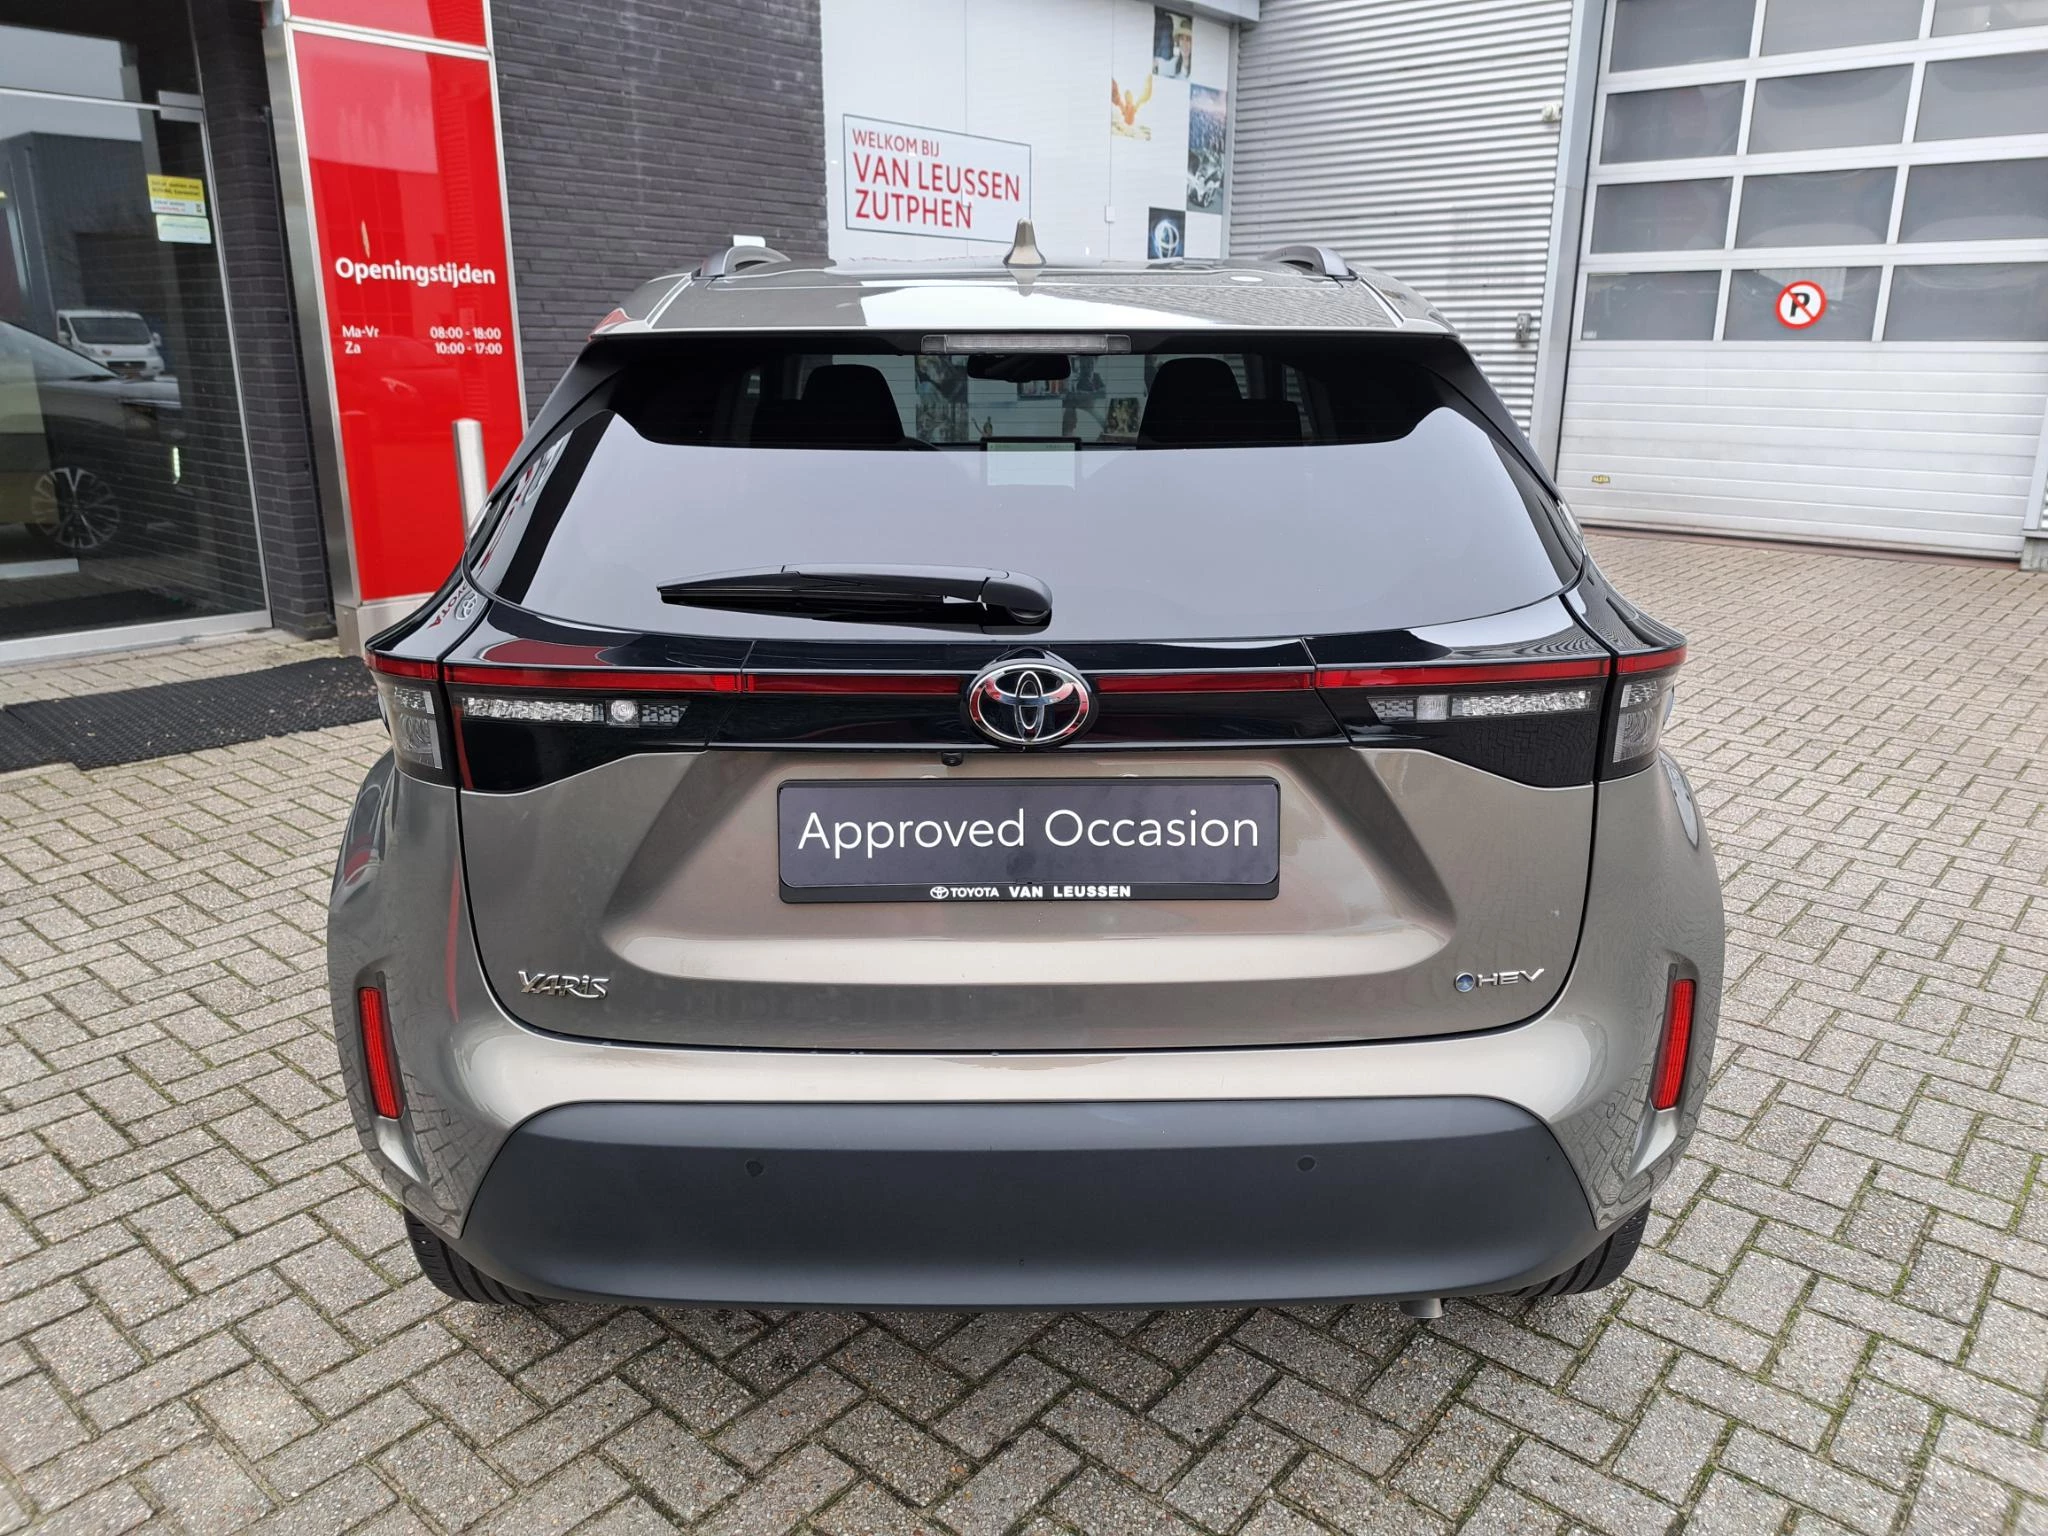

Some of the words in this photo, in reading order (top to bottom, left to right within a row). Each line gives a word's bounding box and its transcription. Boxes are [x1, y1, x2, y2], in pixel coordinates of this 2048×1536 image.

[852, 127, 918, 155] WELKOM
[921, 139, 940, 158] BIJ
[853, 151, 909, 188] VAN
[918, 161, 1020, 202] LEUSSEN
[855, 188, 972, 229] ZUTPHEN
[335, 256, 496, 288] Openingstijden
[341, 325, 379, 339] Ma-Vr
[429, 326, 463, 340] 08:00
[472, 327, 502, 340] 18:00
[344, 340, 362, 354] Za
[434, 341, 465, 355] 10:00
[474, 342, 503, 355] 17:00
[798, 808, 1024, 859] Approved
[1044, 808, 1259, 848] Occasion
[951, 886, 999, 899] TOYOTA
[1008, 886, 1044, 899] VAN
[1053, 885, 1131, 898] LEUSSEN
[1477, 967, 1545, 988] HEV
